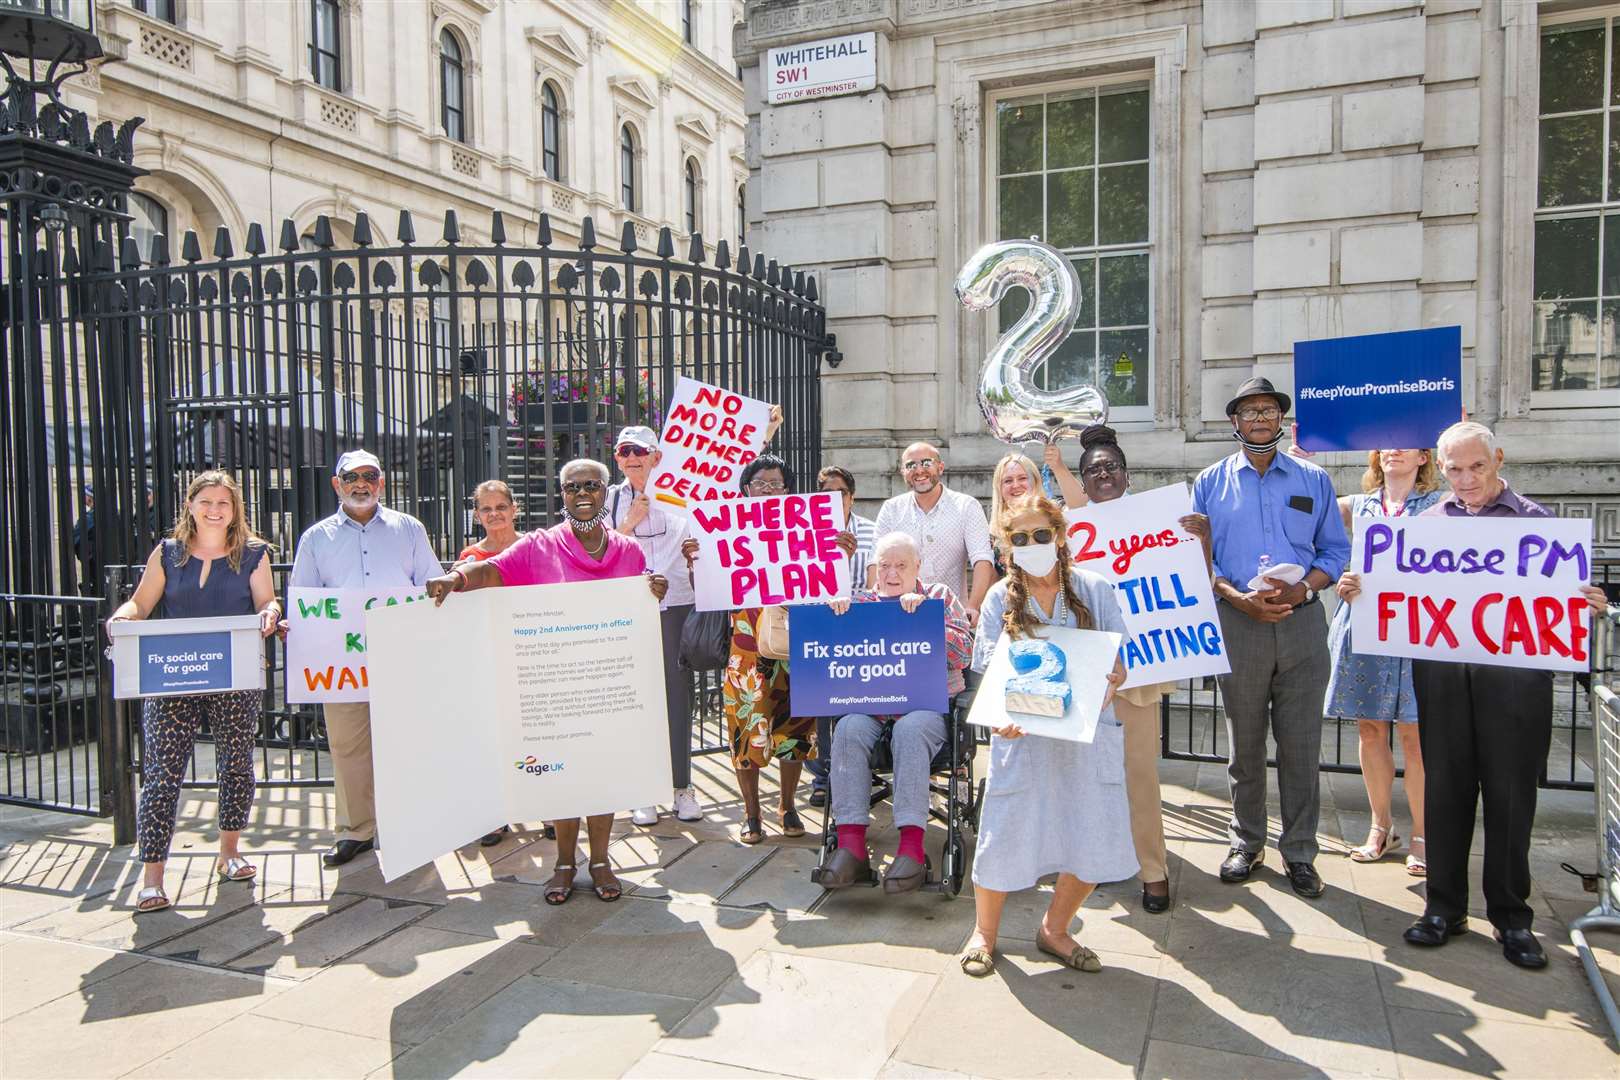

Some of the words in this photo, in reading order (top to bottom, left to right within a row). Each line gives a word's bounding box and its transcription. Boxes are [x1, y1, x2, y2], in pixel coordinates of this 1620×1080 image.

[776, 40, 867, 66] WHITEHALL
[776, 66, 808, 84] SW1
[776, 92, 792, 100] CITY
[806, 82, 858, 96] WESTMINSTER
[693, 388, 742, 415] NO
[1300, 378, 1455, 400] #KeepYourPromiseBoris
[670, 404, 756, 446] MORE
[664, 425, 757, 465] DITHER
[682, 456, 733, 482] AND
[692, 494, 834, 534] WHERE
[717, 536, 754, 568] IS
[758, 529, 842, 563] THE
[1068, 521, 1106, 563] 2
[1363, 524, 1505, 575] Please
[1517, 534, 1588, 582] PM
[731, 561, 839, 606] PLAN
[1112, 573, 1198, 615] TILL
[298, 597, 342, 620] WE
[514, 627, 537, 636] Happy
[540, 625, 553, 634] 2nd
[556, 622, 598, 632] Anniversary
[610, 618, 632, 627] office!
[1378, 592, 1460, 650] FIX
[1472, 592, 1589, 662] CARE
[148, 653, 164, 664] Fix
[166, 652, 197, 662] social
[200, 652, 223, 661] care
[803, 642, 830, 658] Fix
[834, 638, 886, 658] social
[891, 641, 932, 655] care
[163, 664, 178, 674] for
[182, 662, 208, 675] good
[828, 661, 855, 678] for
[860, 659, 906, 682] good
[830, 695, 908, 705] #KeepYourPromiseBoris
[526, 764, 550, 776] age
[550, 762, 564, 772] UK
